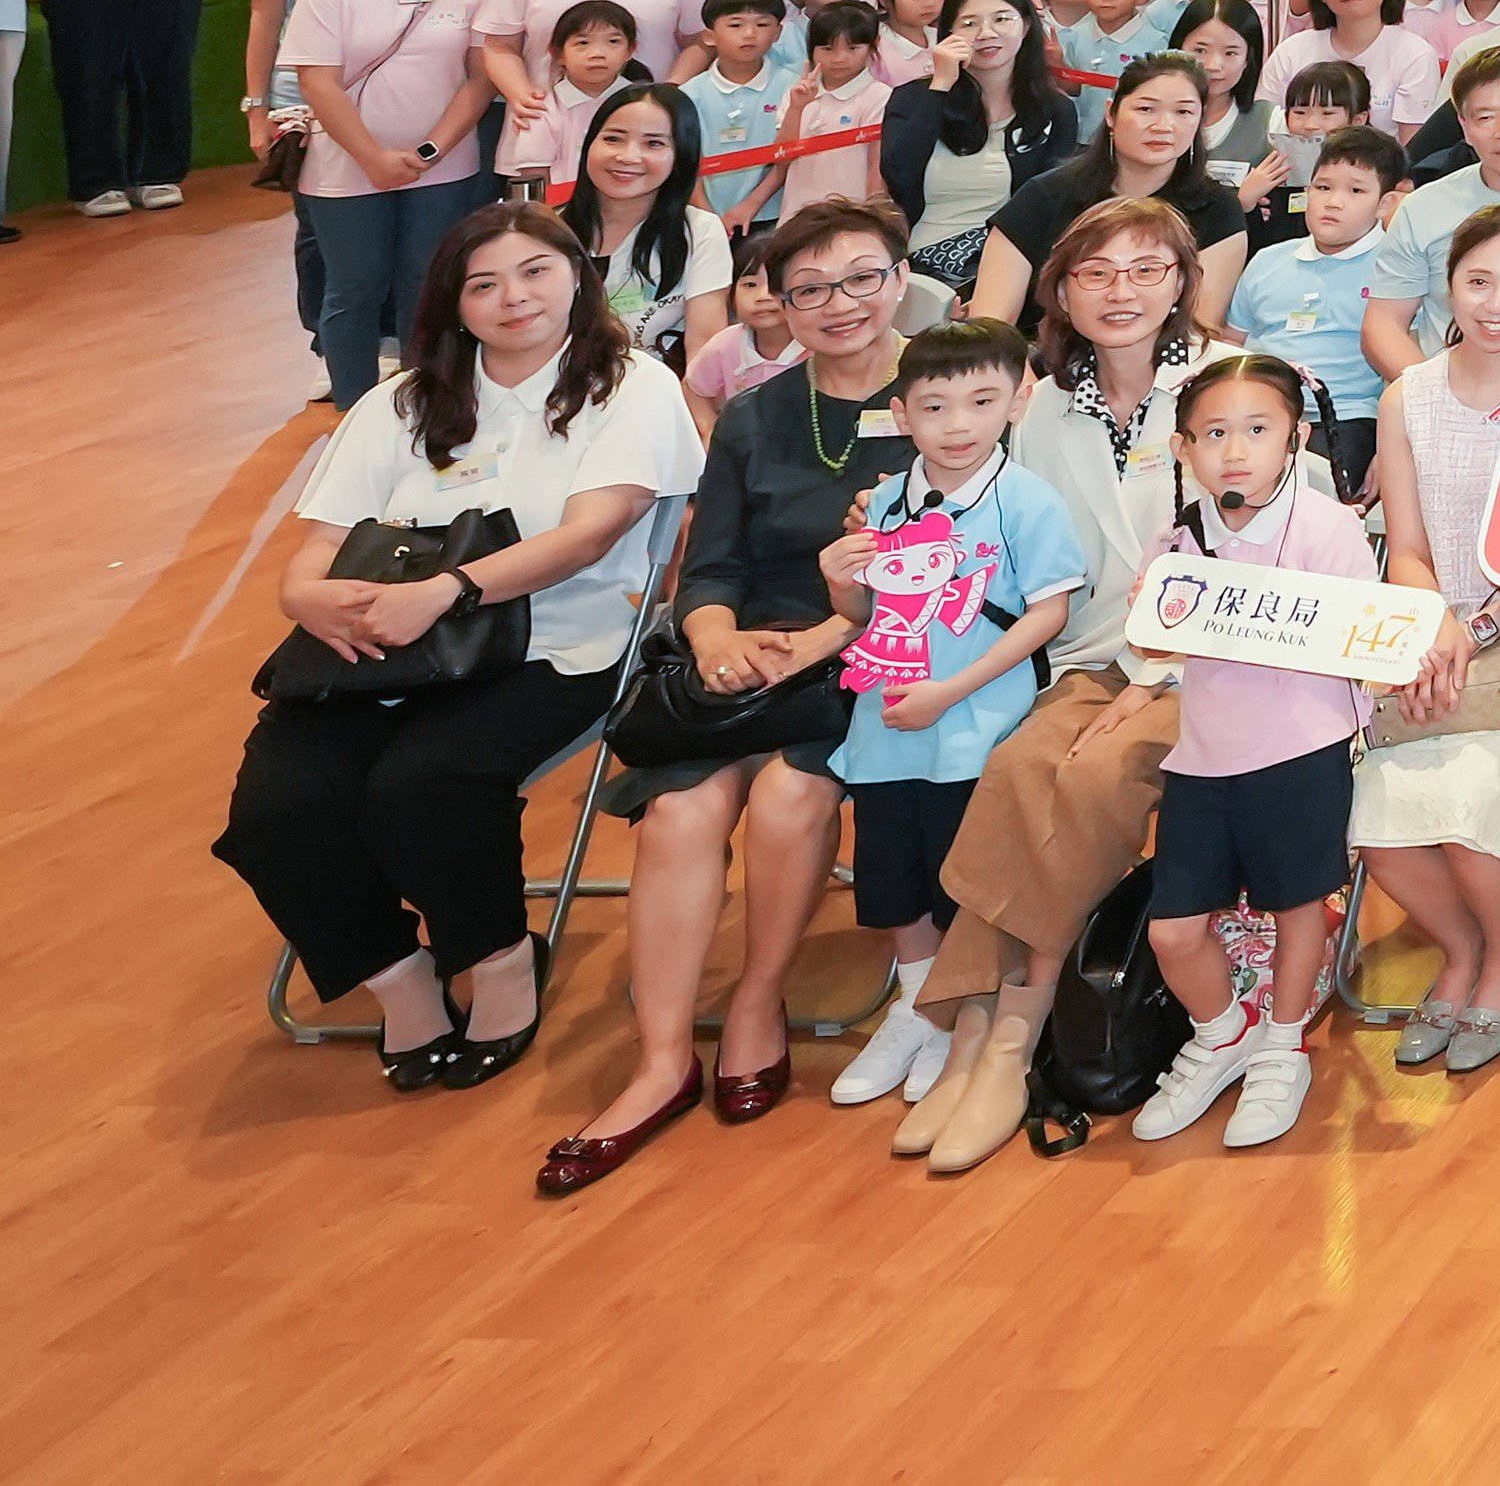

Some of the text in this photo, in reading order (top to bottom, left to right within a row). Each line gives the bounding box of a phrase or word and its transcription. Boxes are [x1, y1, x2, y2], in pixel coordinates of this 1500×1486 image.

[1214, 585, 1321, 629] 保良局
[1203, 618, 1309, 648] PO LEUNG KUK
